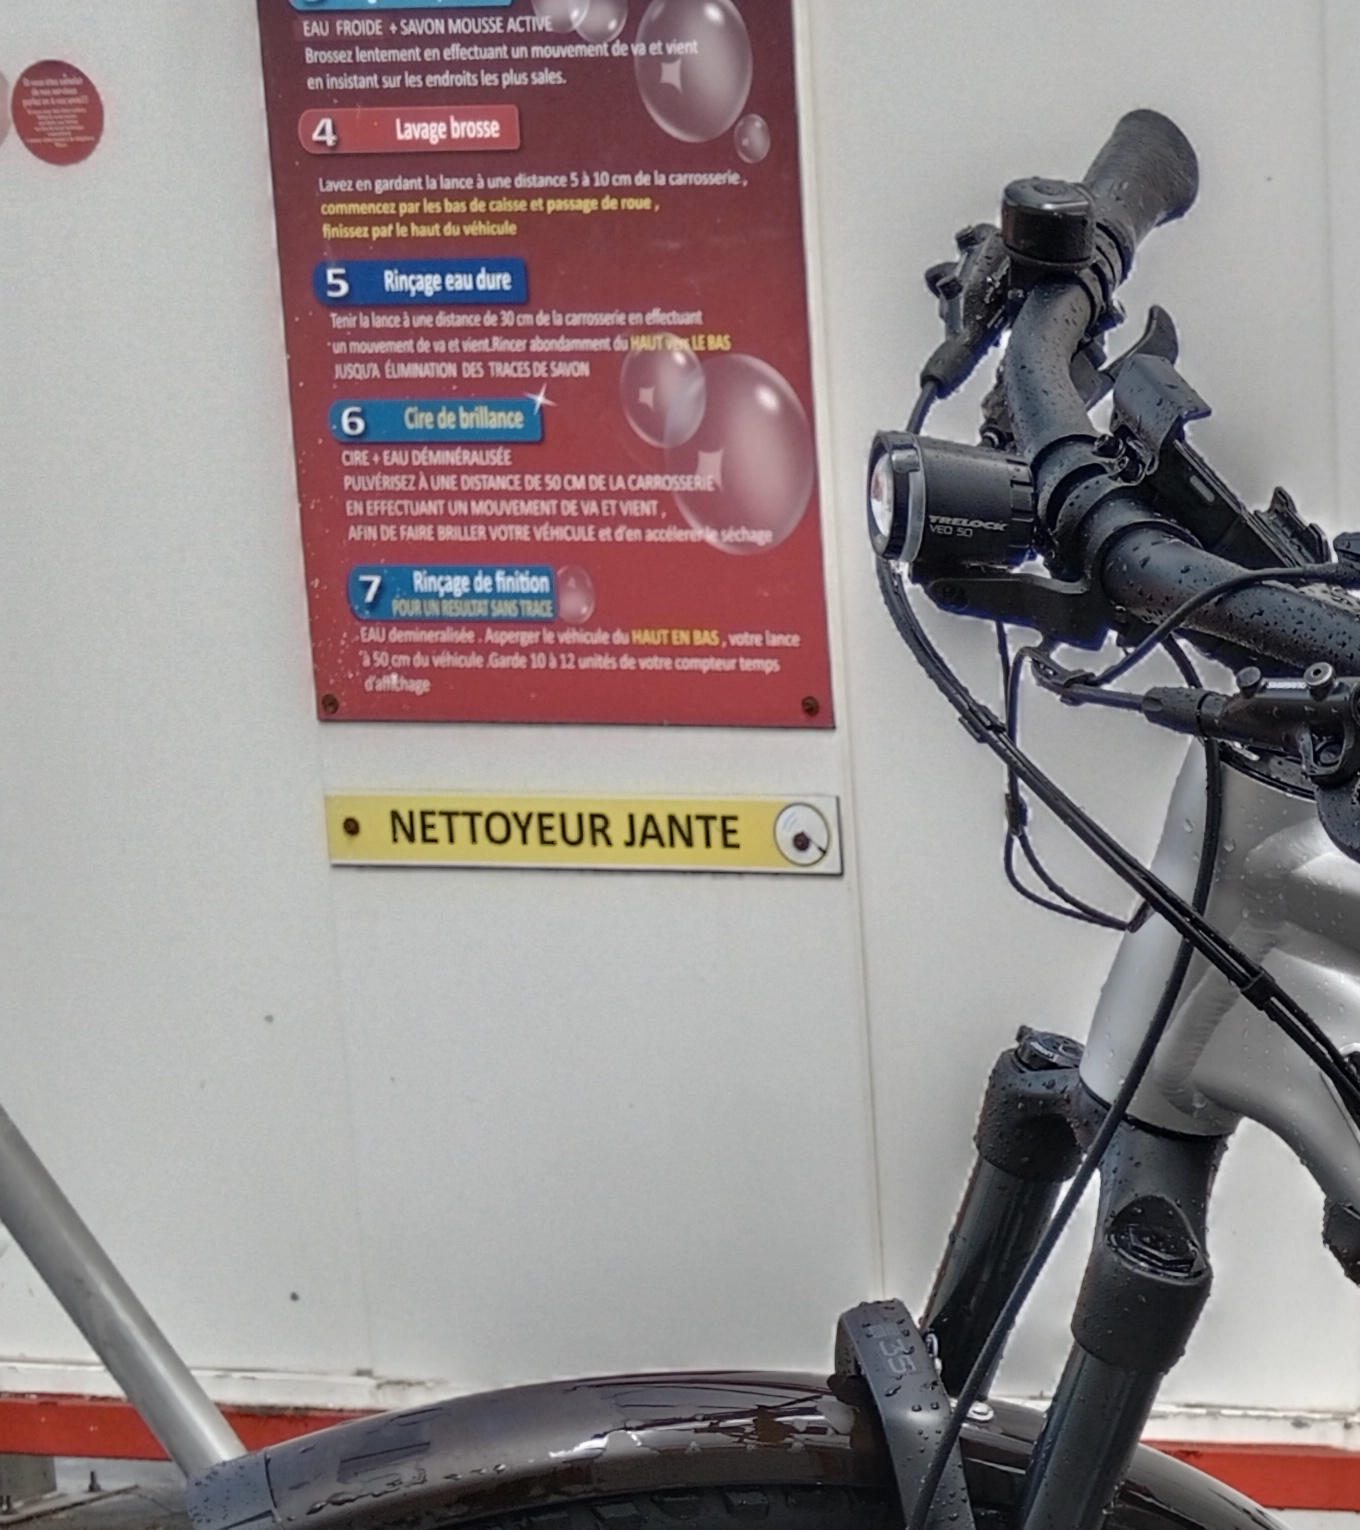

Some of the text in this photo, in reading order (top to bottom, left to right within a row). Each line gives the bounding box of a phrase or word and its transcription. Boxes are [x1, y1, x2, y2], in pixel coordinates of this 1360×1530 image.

[303, 20, 329, 37] EAU
[336, 19, 383, 36] FROIDE
[401, 17, 446, 35] SAVON
[447, 17, 504, 34] MOUSSE
[507, 16, 552, 33] ACTIVE
[304, 38, 698, 64] Brossez lentement en effectuant un mouvement de va et vient
[307, 67, 566, 90] en insistant sur les endroits les plus sales.
[311, 115, 500, 147] 4 Lavage brosse
[319, 177, 354, 192] Lavez
[356, 178, 373, 191] en
[375, 174, 423, 194] gardant
[425, 175, 438, 191] la
[440, 173, 474, 190] lance
[476, 173, 485, 189] à
[487, 175, 512, 189] une
[514, 171, 568, 189] distance
[570, 172, 578, 187] 5
[582, 170, 590, 186] à
[593, 171, 610, 187] 10
[612, 172, 632, 186] cm
[634, 170, 652, 186] de
[654, 170, 666, 186] la
[321, 200, 396, 215] commencez
[399, 201, 420, 216] par
[423, 198, 442, 213] les
[444, 197, 467, 213] bas
[470, 197, 486, 212] de
[489, 197, 527, 212] caisse
[530, 197, 544, 211] et
[547, 198, 598, 214] passage
[601, 195, 618, 210] de
[323, 220, 517, 240] finissez par le haut du véhicule
[326, 267, 512, 297] 5 Rinçage eau dure
[331, 308, 703, 329] Tenir la lance à une distance de 30 cm de la carrosserie en effectuant
[335, 361, 590, 380] JUSQU'A ÉLIMINATION DES TRACES DE SAVON
[341, 406, 524, 435] 6 Cire de brillance
[341, 450, 369, 466] CIRE
[383, 450, 409, 466] EAU
[411, 446, 512, 466] DÉMINÉRALISÉE
[344, 471, 715, 491] PULVÉRISEZ À UNE DISTANCE DE 50 CM DE LA CARROSSERIE
[346, 500, 363, 516] EN
[366, 500, 445, 516] EFFECTUANT
[448, 500, 467, 516] UN
[471, 500, 558, 516] MOUVEMENT
[561, 500, 578, 516] DE
[580, 500, 600, 516] VA
[602, 500, 617, 516] ET
[928, 515, 1009, 531] TRELOCK
[348, 525, 377, 541] AFIN
[380, 525, 397, 541] DE
[400, 525, 434, 541] FAIRE
[437, 525, 487, 541] BRILLER
[489, 525, 531, 541] VOTRE
[533, 522, 595, 541] VÉHICULE
[598, 526, 612, 541] et
[614, 525, 642, 541] d'en
[721, 525, 773, 547] séchage
[359, 570, 550, 603] 7 Rinçage de finition
[390, 810, 741, 849] NETTOYEUR JANTE
